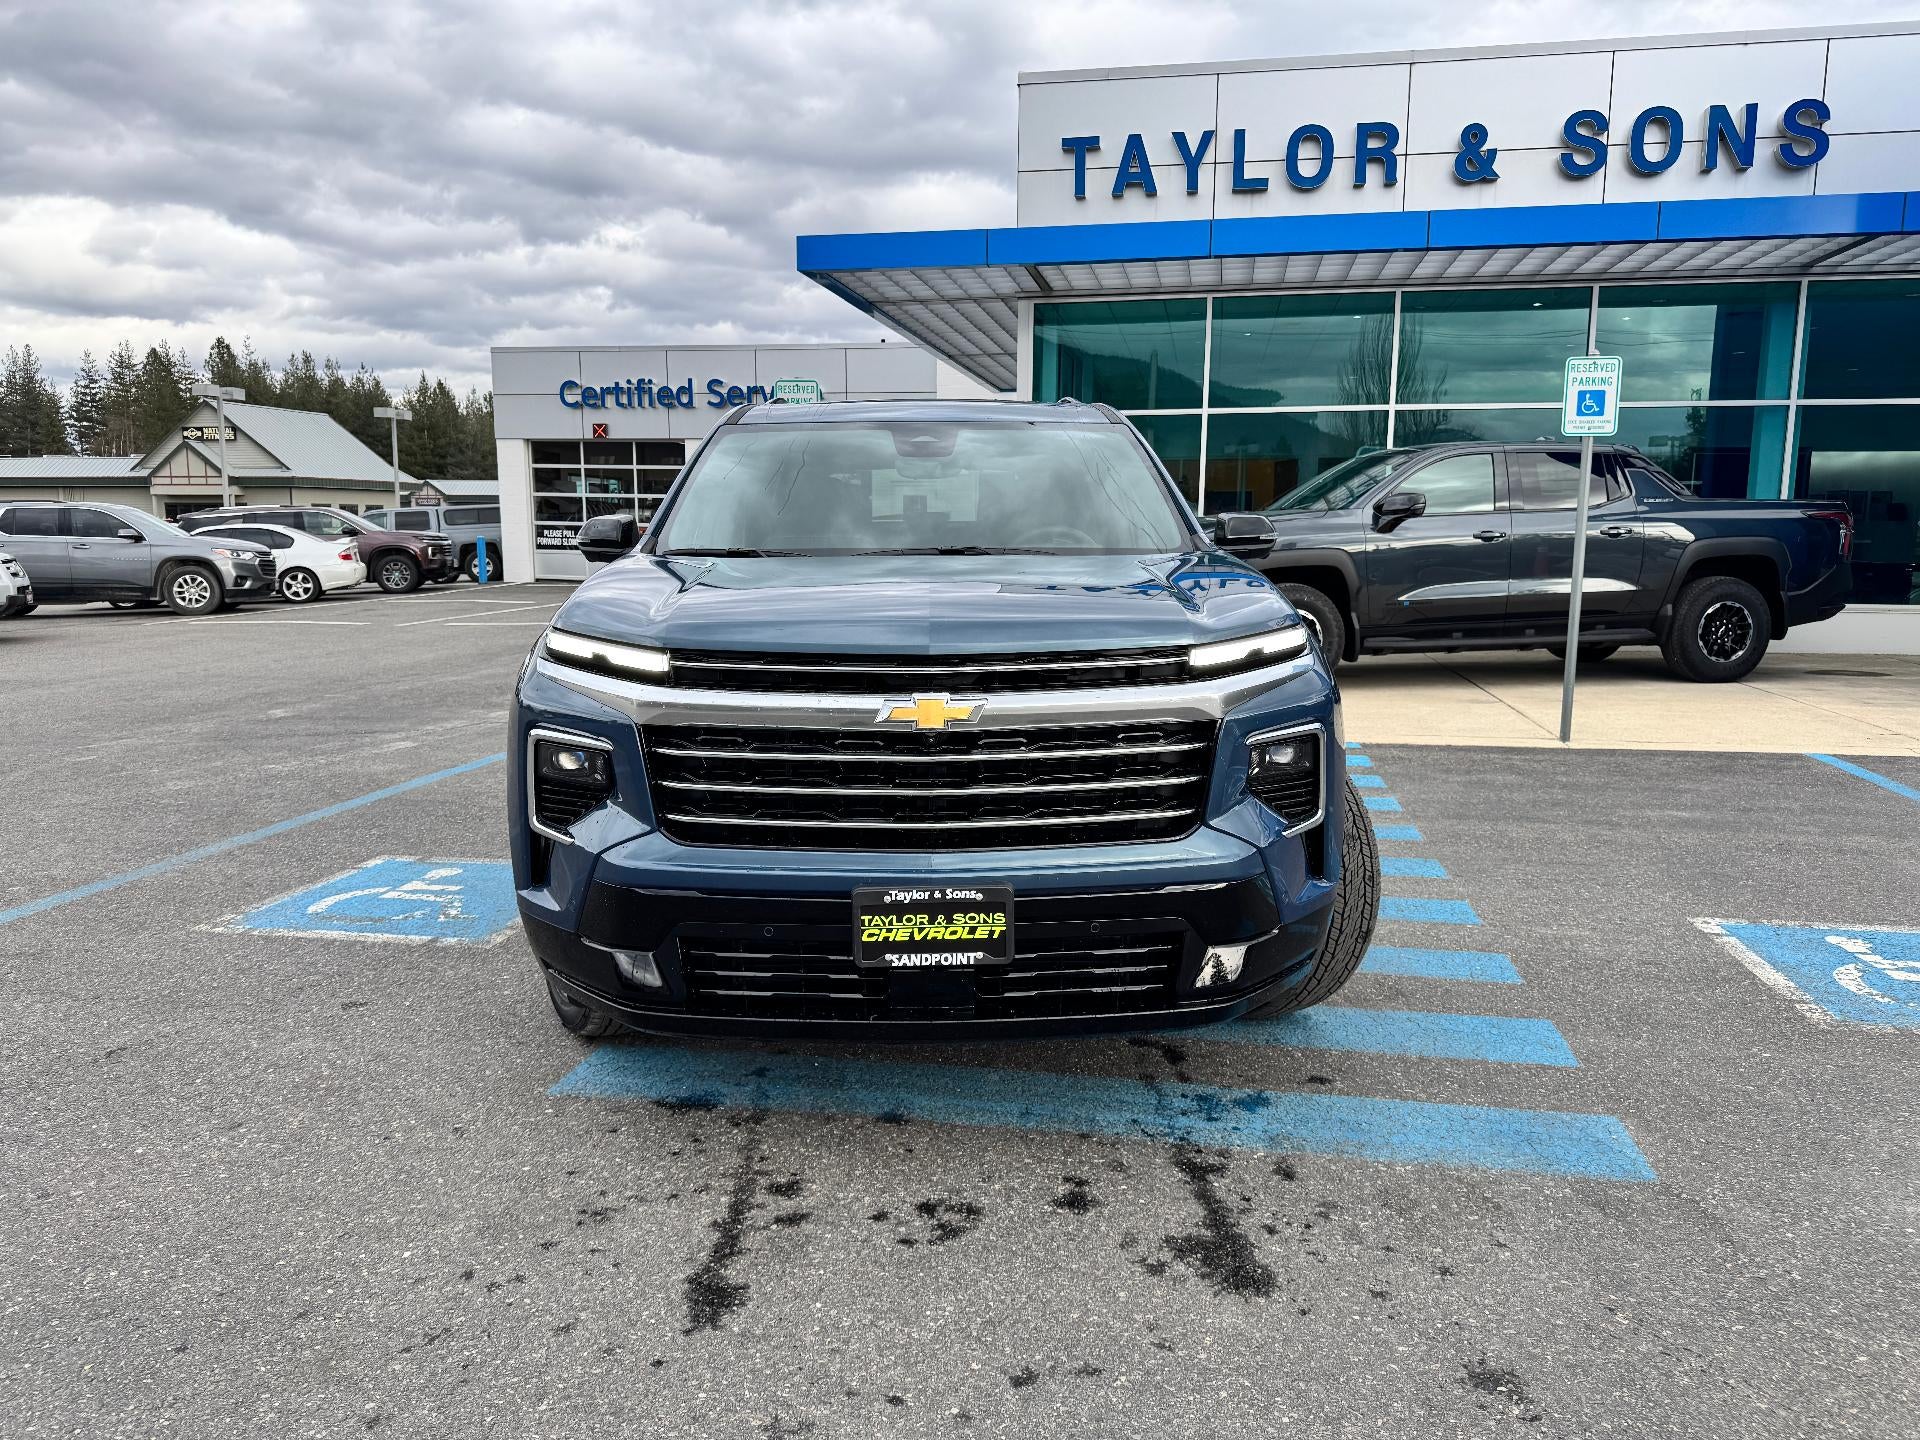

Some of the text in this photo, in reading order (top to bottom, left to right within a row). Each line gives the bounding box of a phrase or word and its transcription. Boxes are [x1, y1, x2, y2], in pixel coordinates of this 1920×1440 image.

[1061, 98, 1832, 199] TAYLOR & SONS
[1570, 362, 1616, 373] RESERVED
[1571, 376, 1613, 387] PARKING
[559, 378, 695, 409] Certified
[778, 385, 815, 394] RESERVED
[543, 529, 575, 538] PLEASE PULL
[537, 537, 562, 546] FORWARD
[889, 888, 976, 904] Taylor & Sons
[861, 912, 1006, 927] TAYLOR & SONS
[861, 926, 1006, 942] CHEVROLET
[891, 952, 977, 967] SANDPOINT
